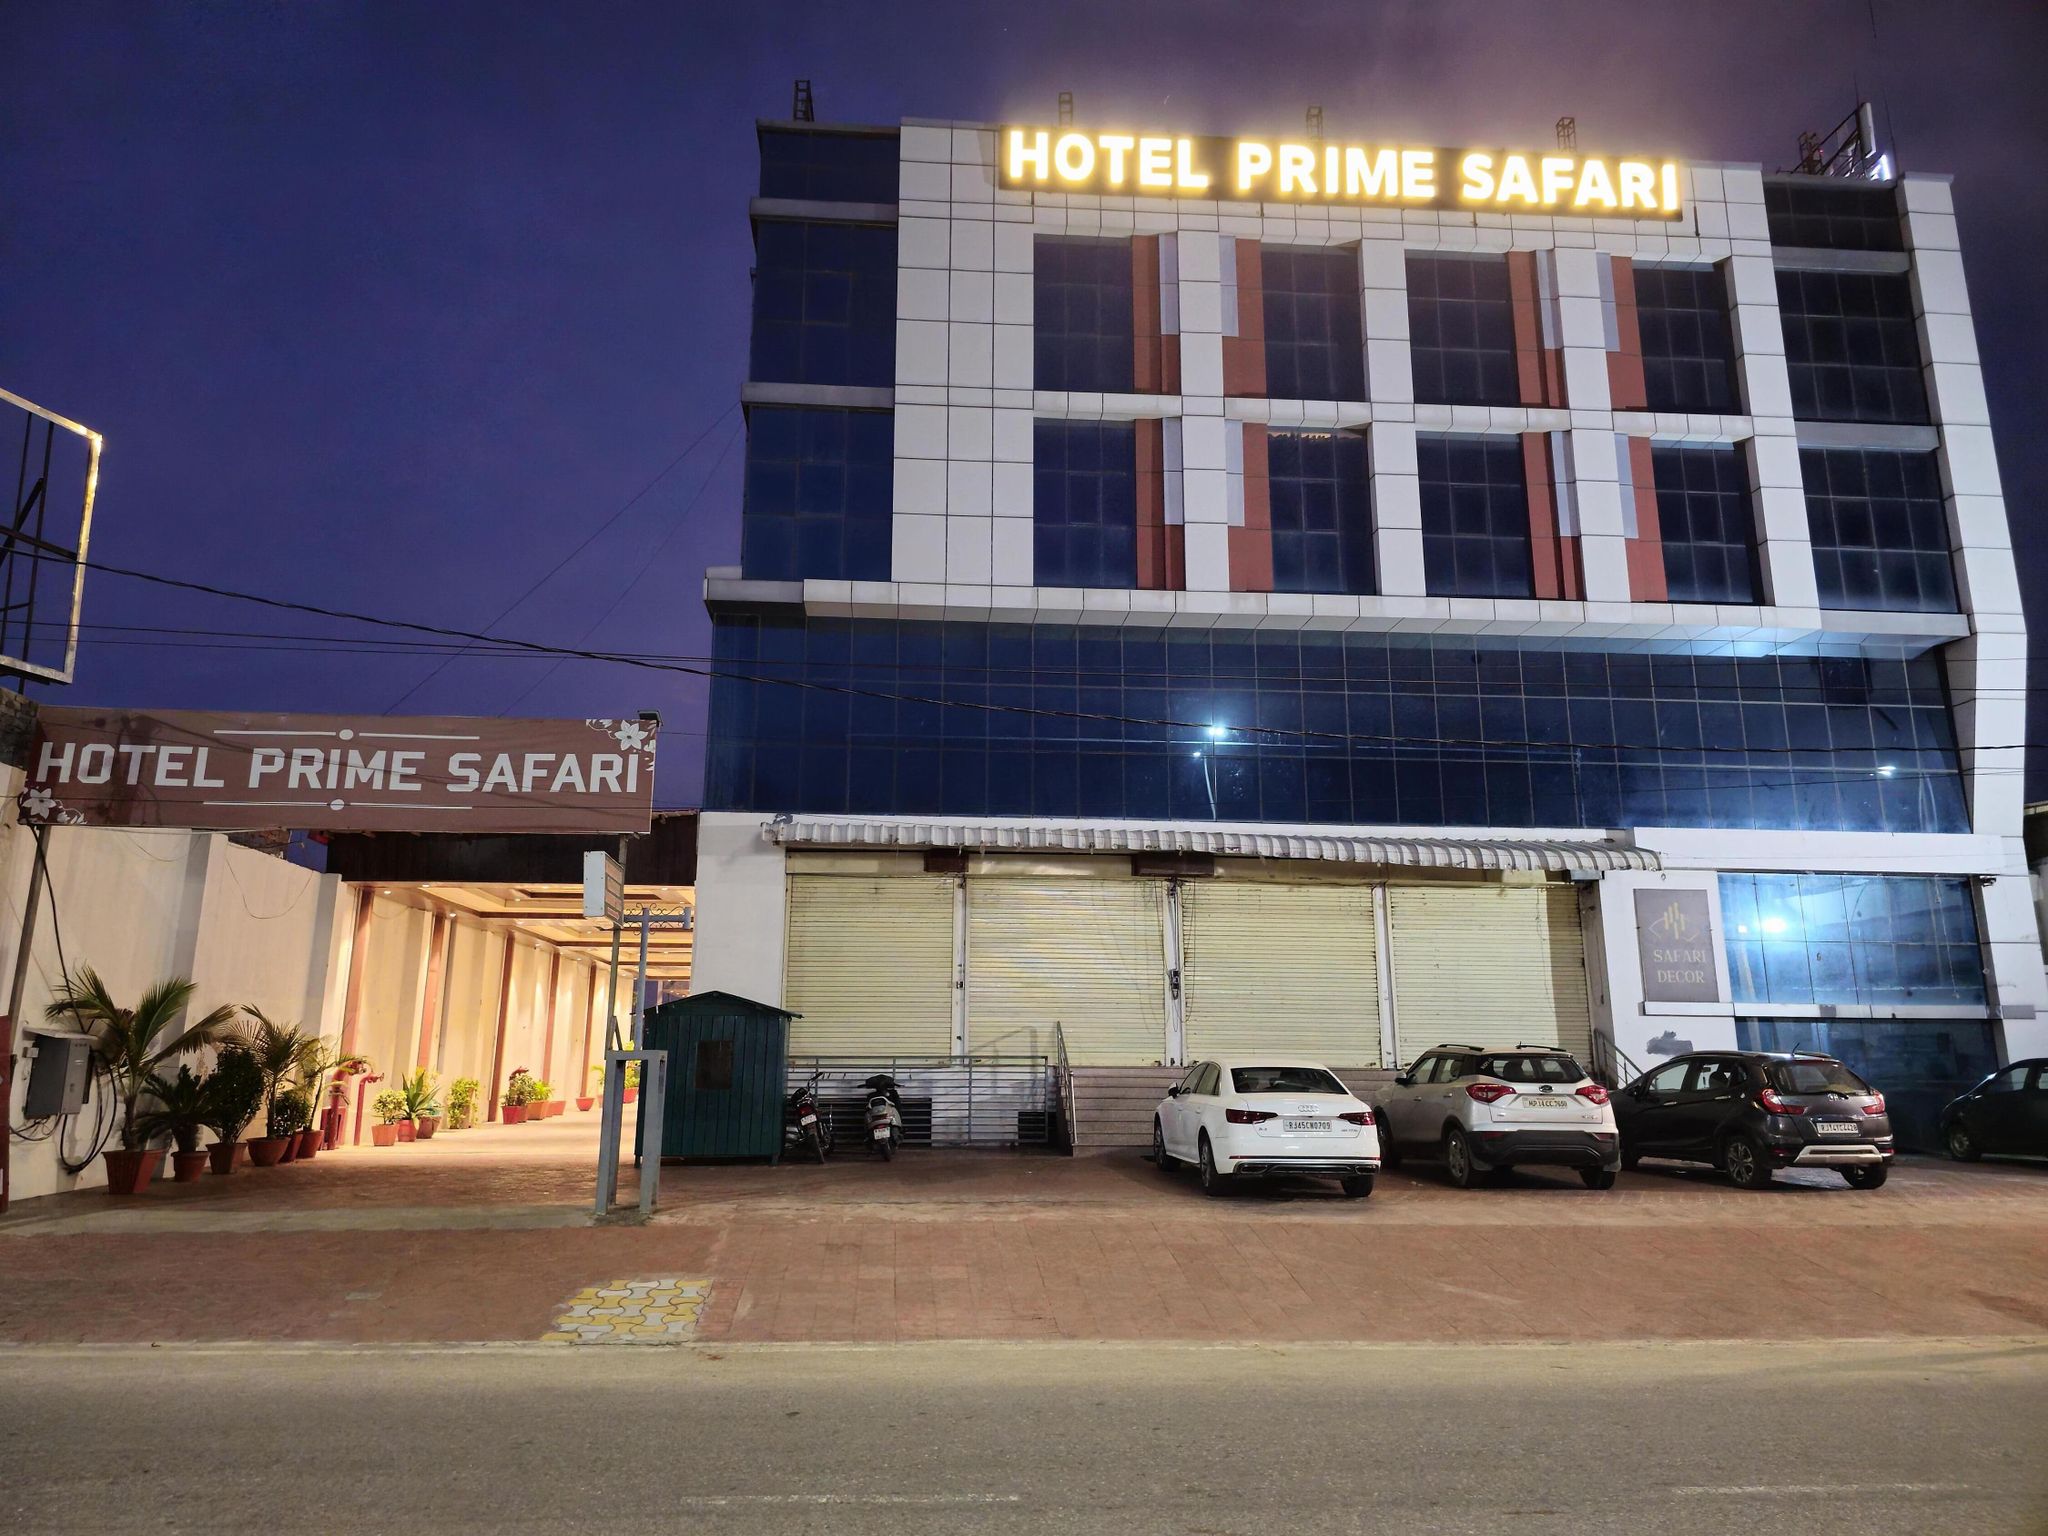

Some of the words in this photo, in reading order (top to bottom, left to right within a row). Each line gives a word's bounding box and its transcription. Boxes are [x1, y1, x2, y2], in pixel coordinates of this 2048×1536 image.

[1006, 128, 1212, 193] HOTEL
[1234, 140, 1437, 202] PRIME
[1459, 150, 1680, 213] SAFARI
[36, 741, 225, 788] HOTEL
[247, 747, 426, 791] PRIME
[446, 752, 639, 793] SAFARI
[1653, 950, 1707, 963] SAFARI
[1657, 970, 1705, 984] DECOR
